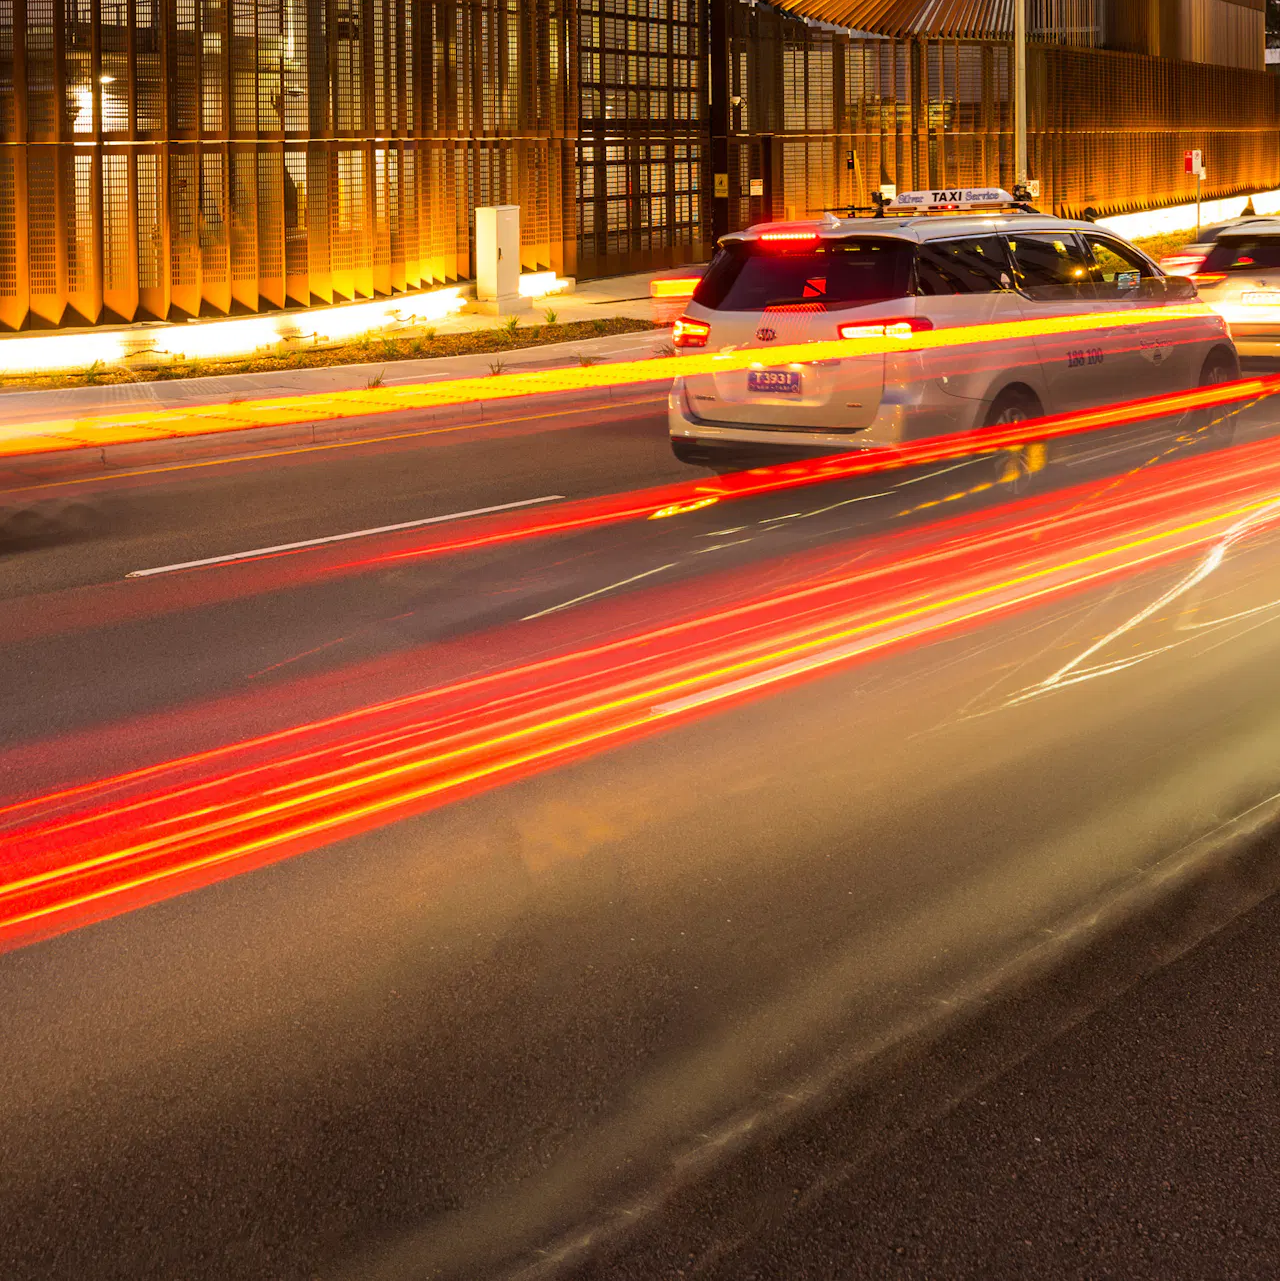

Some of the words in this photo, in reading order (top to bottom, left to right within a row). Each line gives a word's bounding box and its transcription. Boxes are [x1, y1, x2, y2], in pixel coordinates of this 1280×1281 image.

[898, 194, 924, 204] Silver
[932, 191, 962, 202] TAXI
[965, 190, 999, 201] Service
